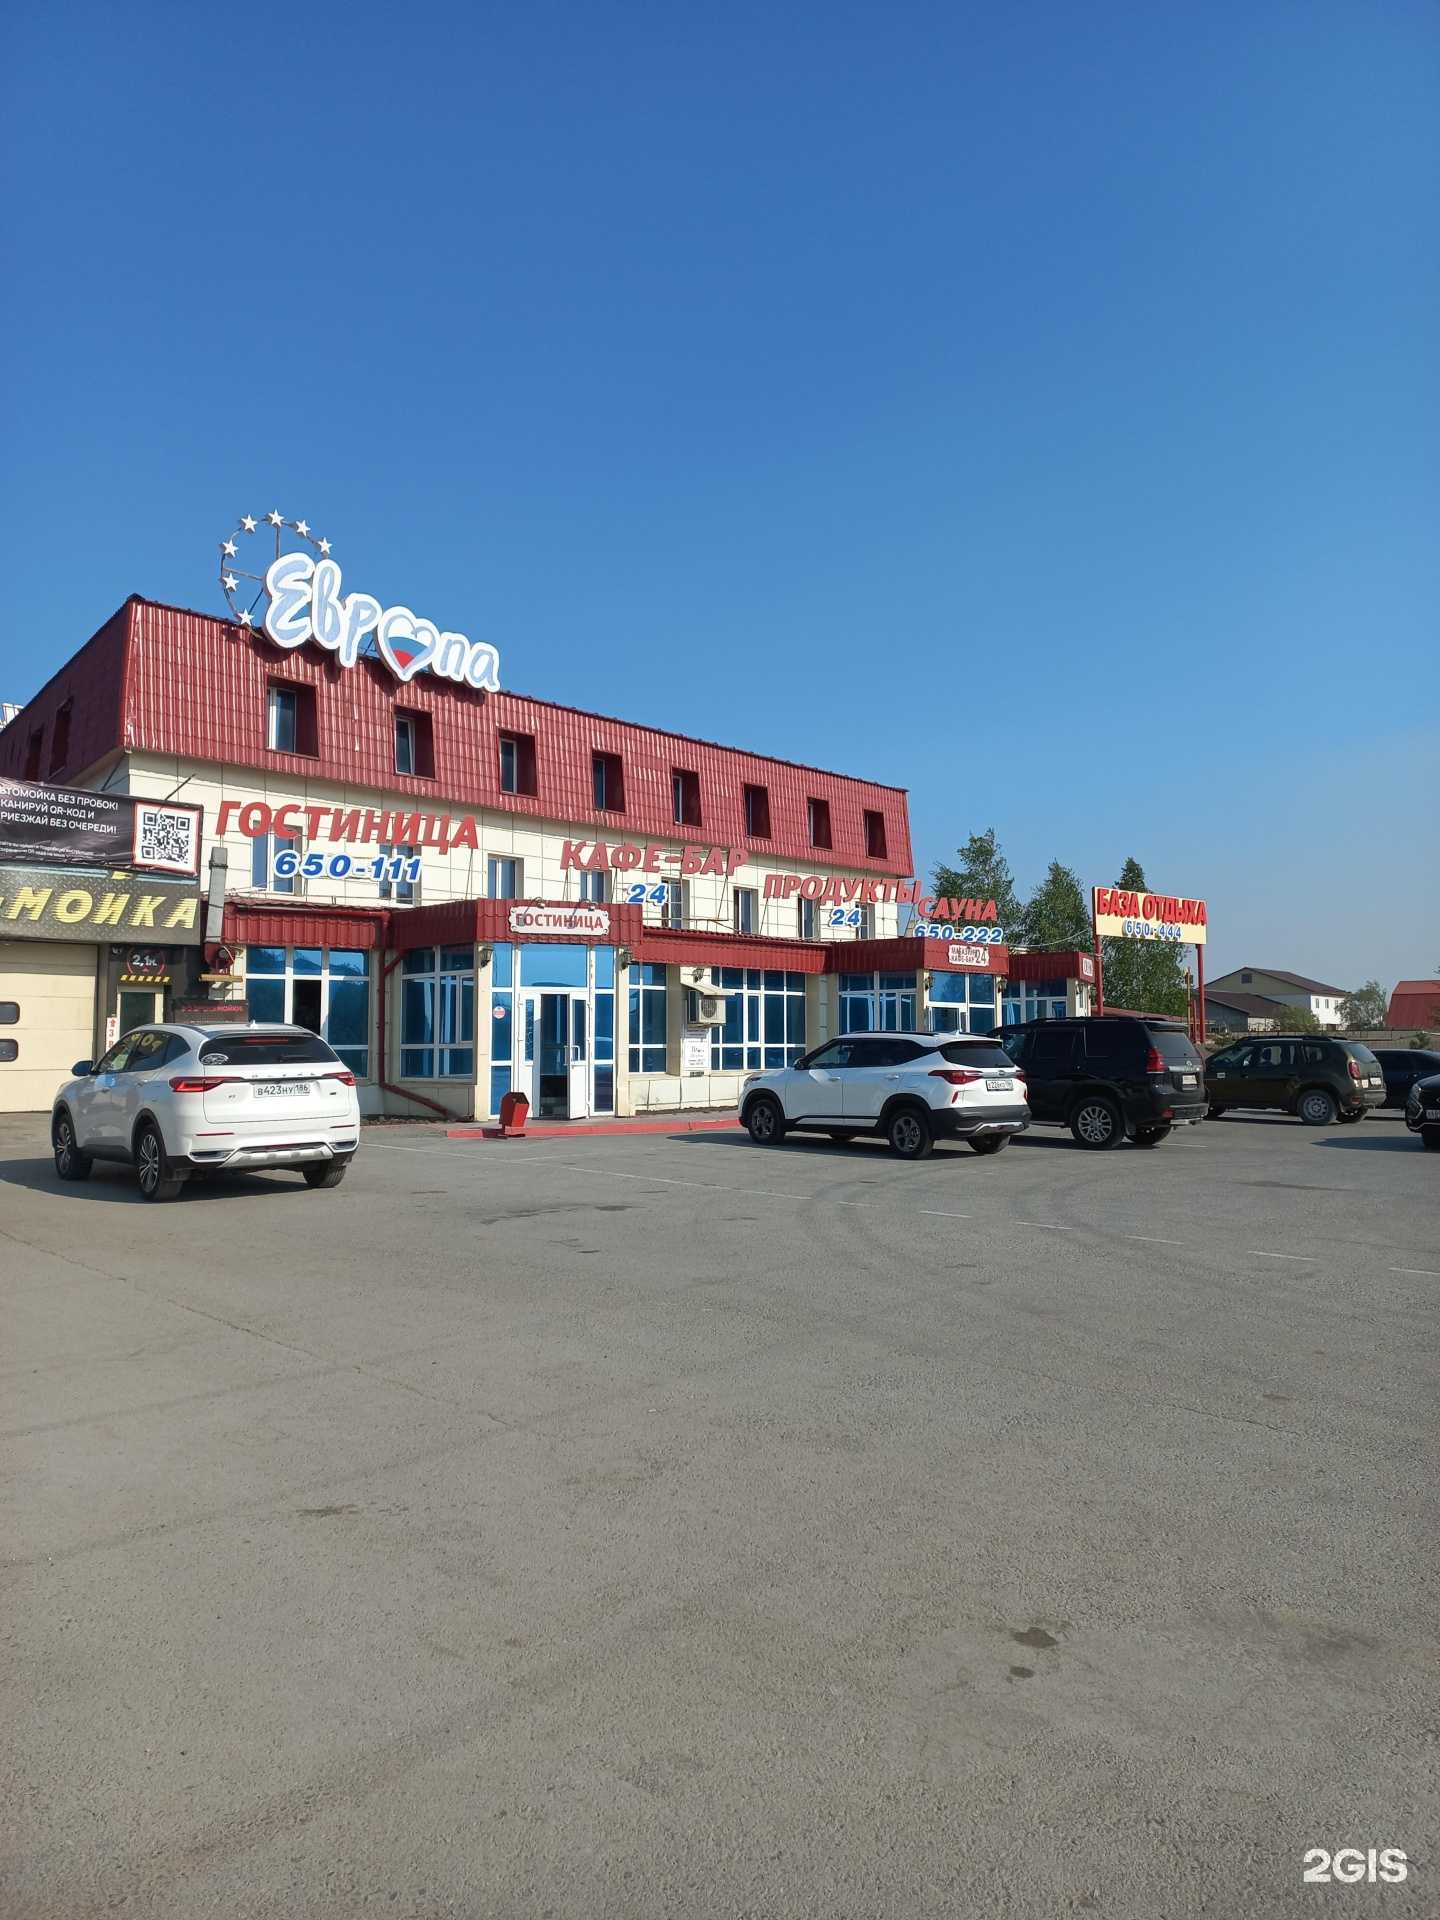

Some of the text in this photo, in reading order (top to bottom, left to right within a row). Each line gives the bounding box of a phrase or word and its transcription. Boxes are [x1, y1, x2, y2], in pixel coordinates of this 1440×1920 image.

[265, 552, 500, 692] Европа
[50, 807, 86, 818] QR-КОД
[88, 811, 95, 819] И
[58, 794, 75, 804] БЕЗ
[77, 797, 119, 810] ПРОБОК!
[1, 812, 117, 834] РИЕЗЖАЙ БЕЗ ОЧЕРЕДИ!
[215, 800, 479, 855] ГОСТИНИЦА
[274, 849, 423, 883] 650-111
[560, 840, 749, 876] КАФЕ-БАР
[626, 882, 670, 906] 24
[763, 874, 921, 906] ПРОДУКТЫ
[830, 907, 861, 928] 24
[917, 896, 998, 921] САУНА
[1097, 888, 1207, 926] БАЗА ОТДЫХА
[515, 913, 603, 930] ГОСТИНИЦА
[914, 925, 1003, 943] 650-222
